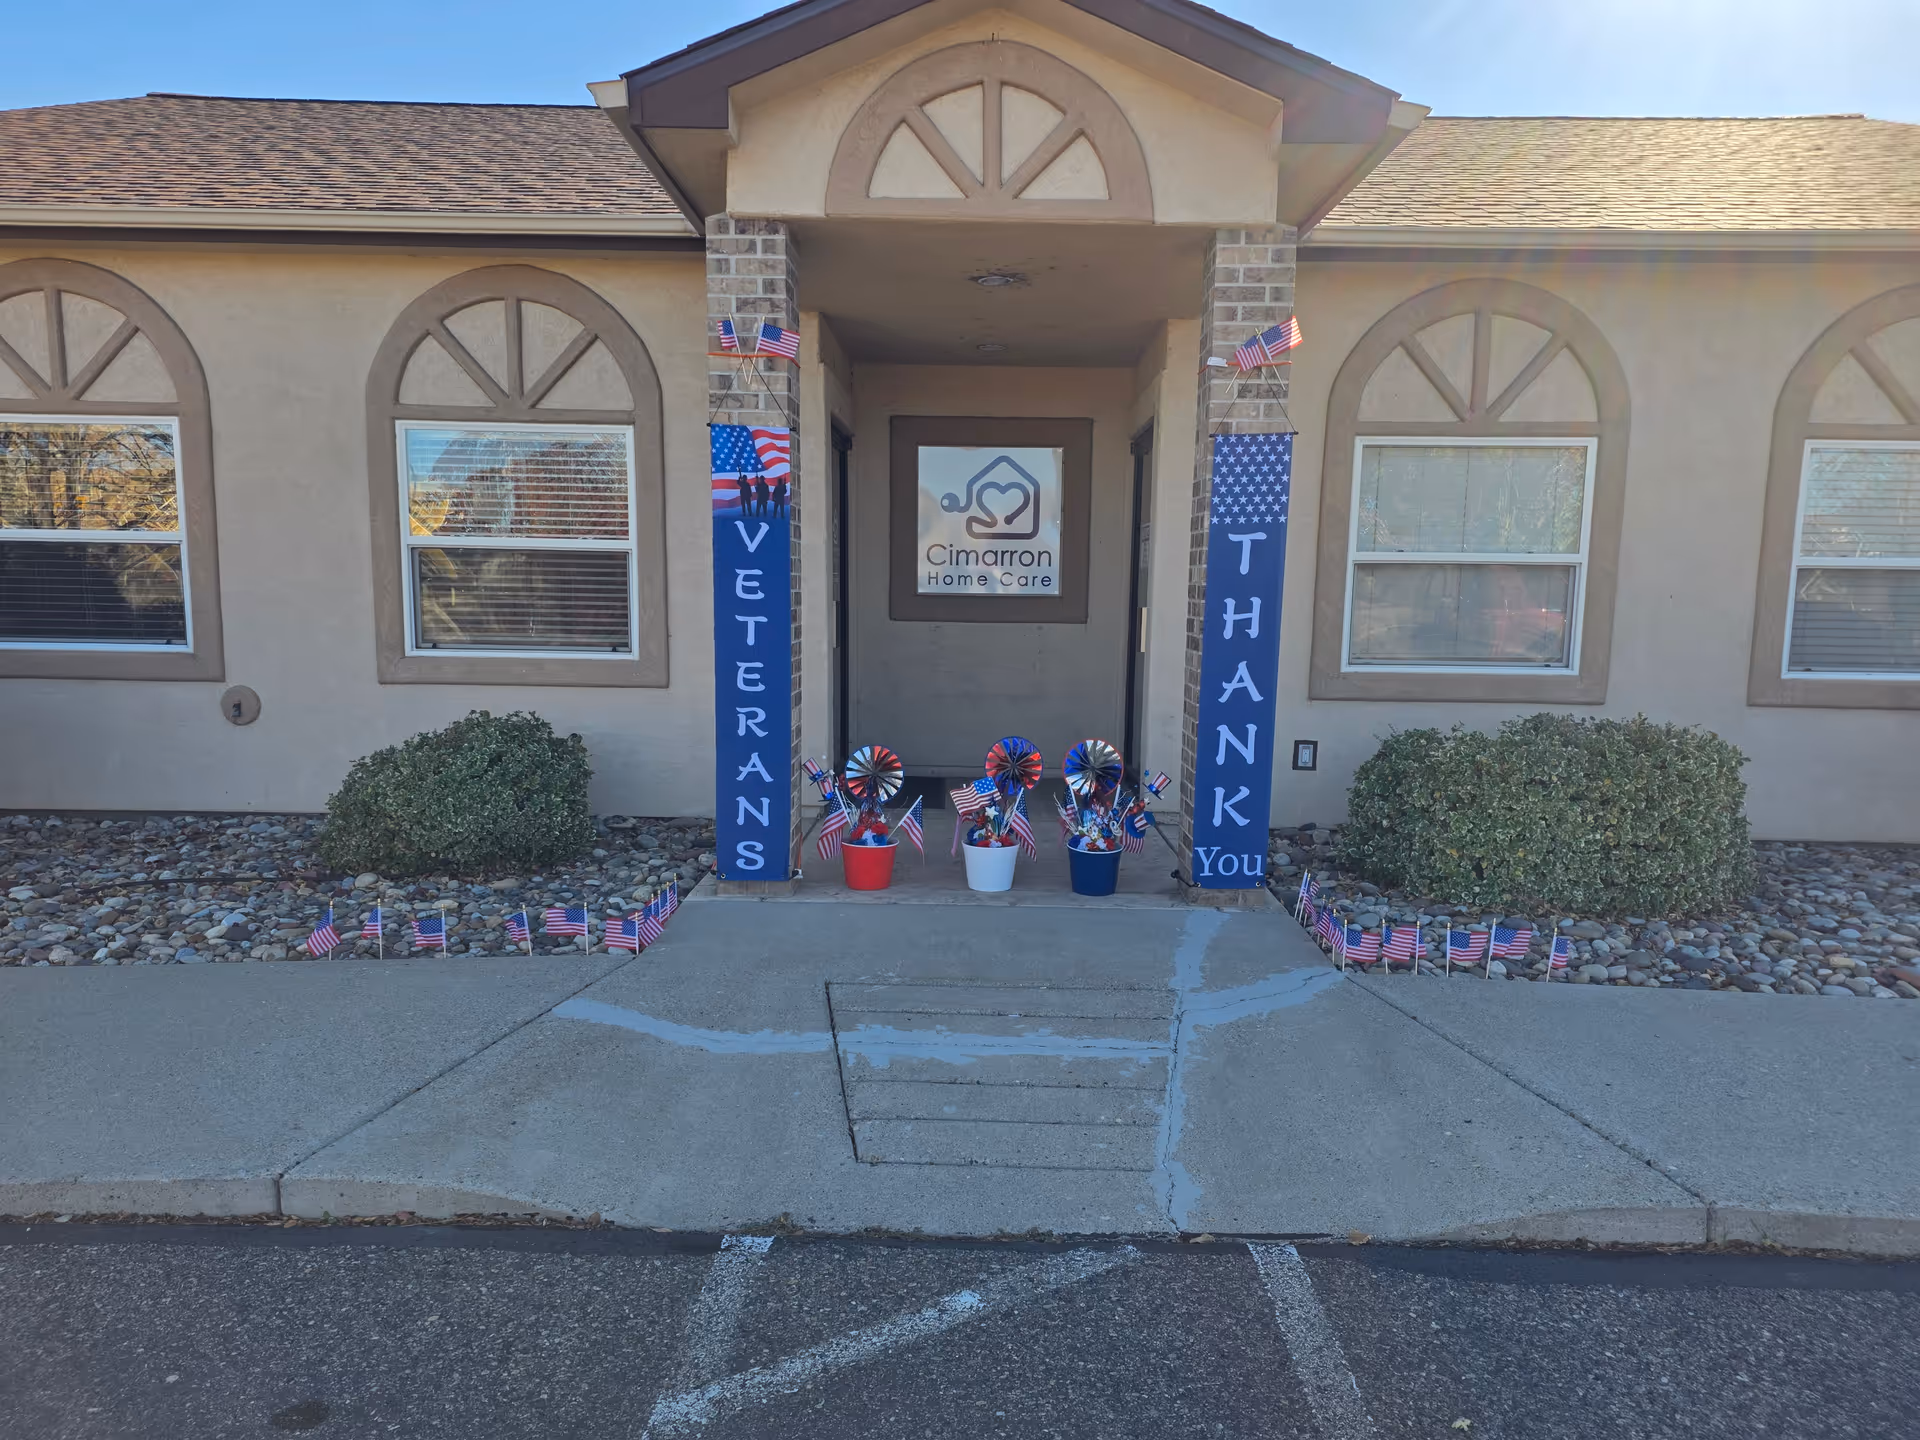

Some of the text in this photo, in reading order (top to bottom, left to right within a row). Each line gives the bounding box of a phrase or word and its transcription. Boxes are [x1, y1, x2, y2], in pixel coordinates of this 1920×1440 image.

[926, 543, 1052, 567] Cimarron
[927, 571, 1052, 587] Home Care
[1212, 531, 1268, 828] THANK
[733, 520, 774, 872] VETERANS
[1194, 846, 1264, 877] You
